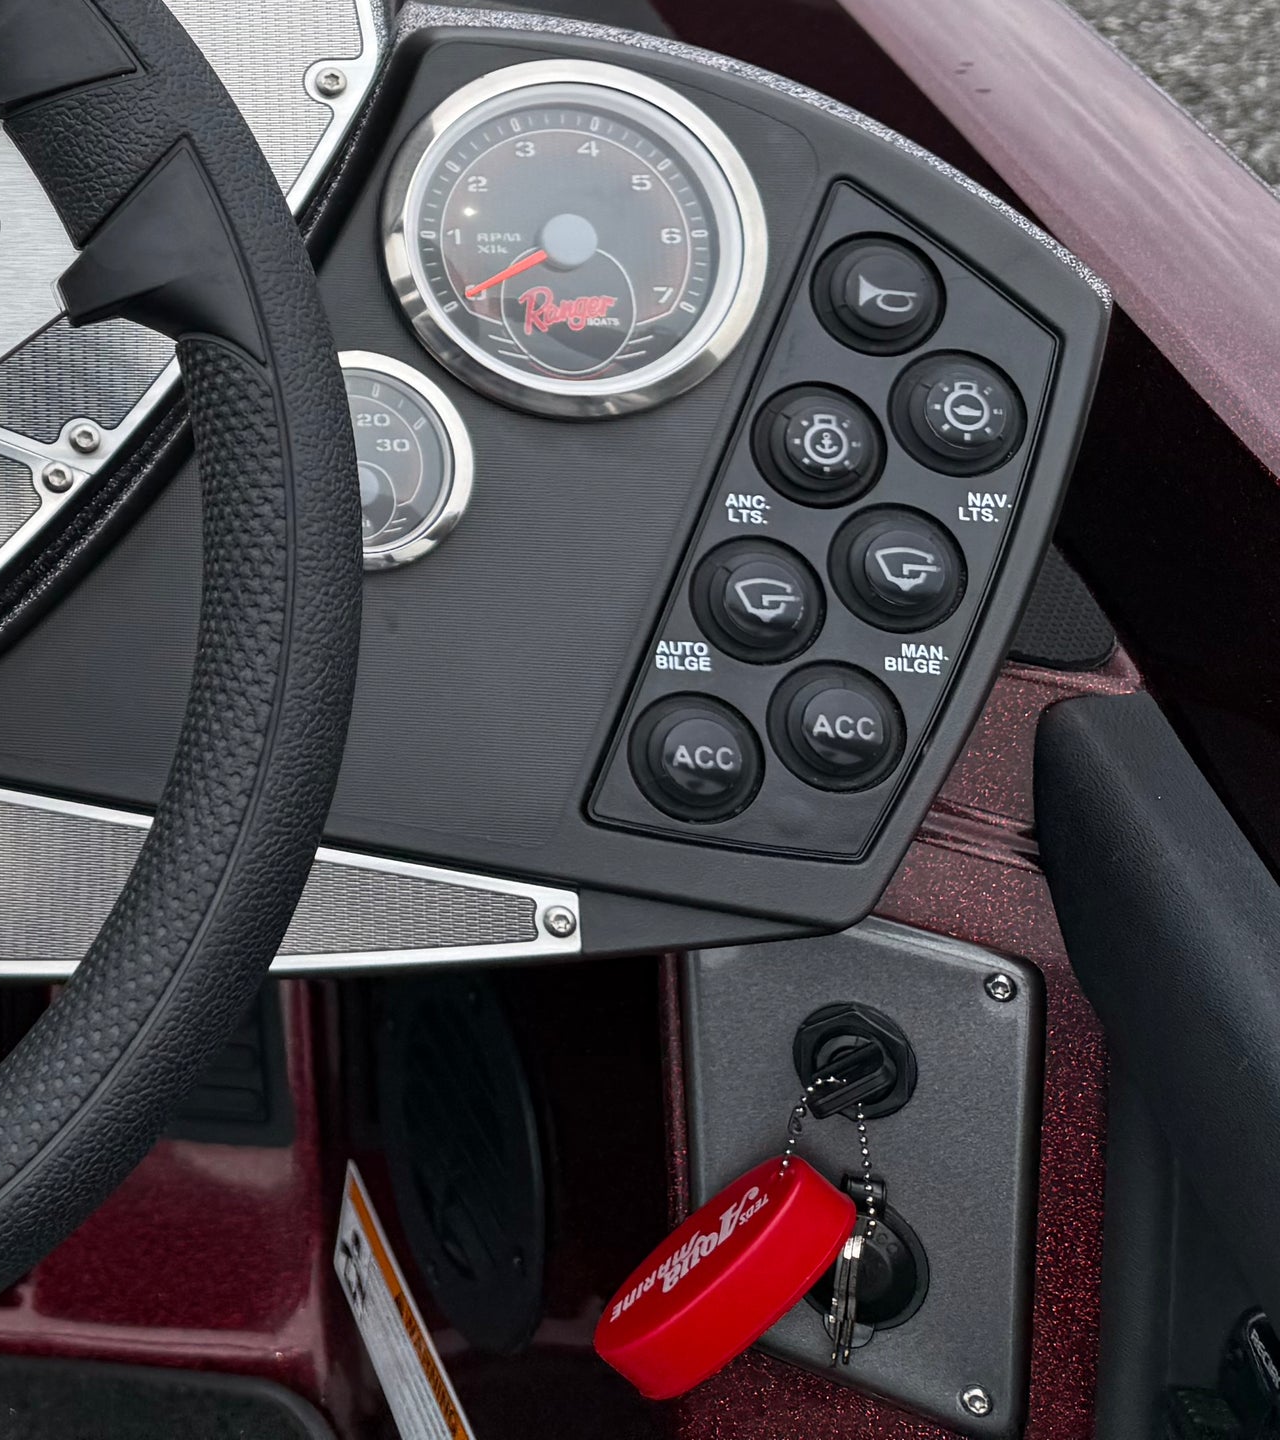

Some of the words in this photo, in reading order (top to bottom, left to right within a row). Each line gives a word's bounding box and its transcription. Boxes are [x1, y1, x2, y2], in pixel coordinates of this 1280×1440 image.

[515, 141, 536, 158] 3
[577, 141, 600, 157] 4
[467, 175, 489, 193] 2
[631, 174, 652, 191] 5
[446, 228, 461, 245] 1
[476, 232, 522, 242] RPM
[660, 227, 682, 244] 6
[652, 286, 674, 304] 7
[518, 286, 618, 335] Ranger
[587, 317, 620, 327] BOATS
[356, 413, 390, 427] 20
[376, 438, 410, 452] 30
[725, 493, 771, 510] ANC.
[967, 491, 1012, 508] NAV.
[728, 508, 769, 525] LTS.
[958, 506, 999, 523] LTS.
[656, 640, 708, 656] AUTO
[901, 643, 949, 661] MAN.
[655, 655, 712, 672] BILGE
[884, 657, 942, 675] BILGE
[812, 714, 875, 741] ACC
[672, 744, 734, 771] ACC
[661, 1186, 760, 1294] Aqua
[609, 1230, 701, 1323] MARINE
